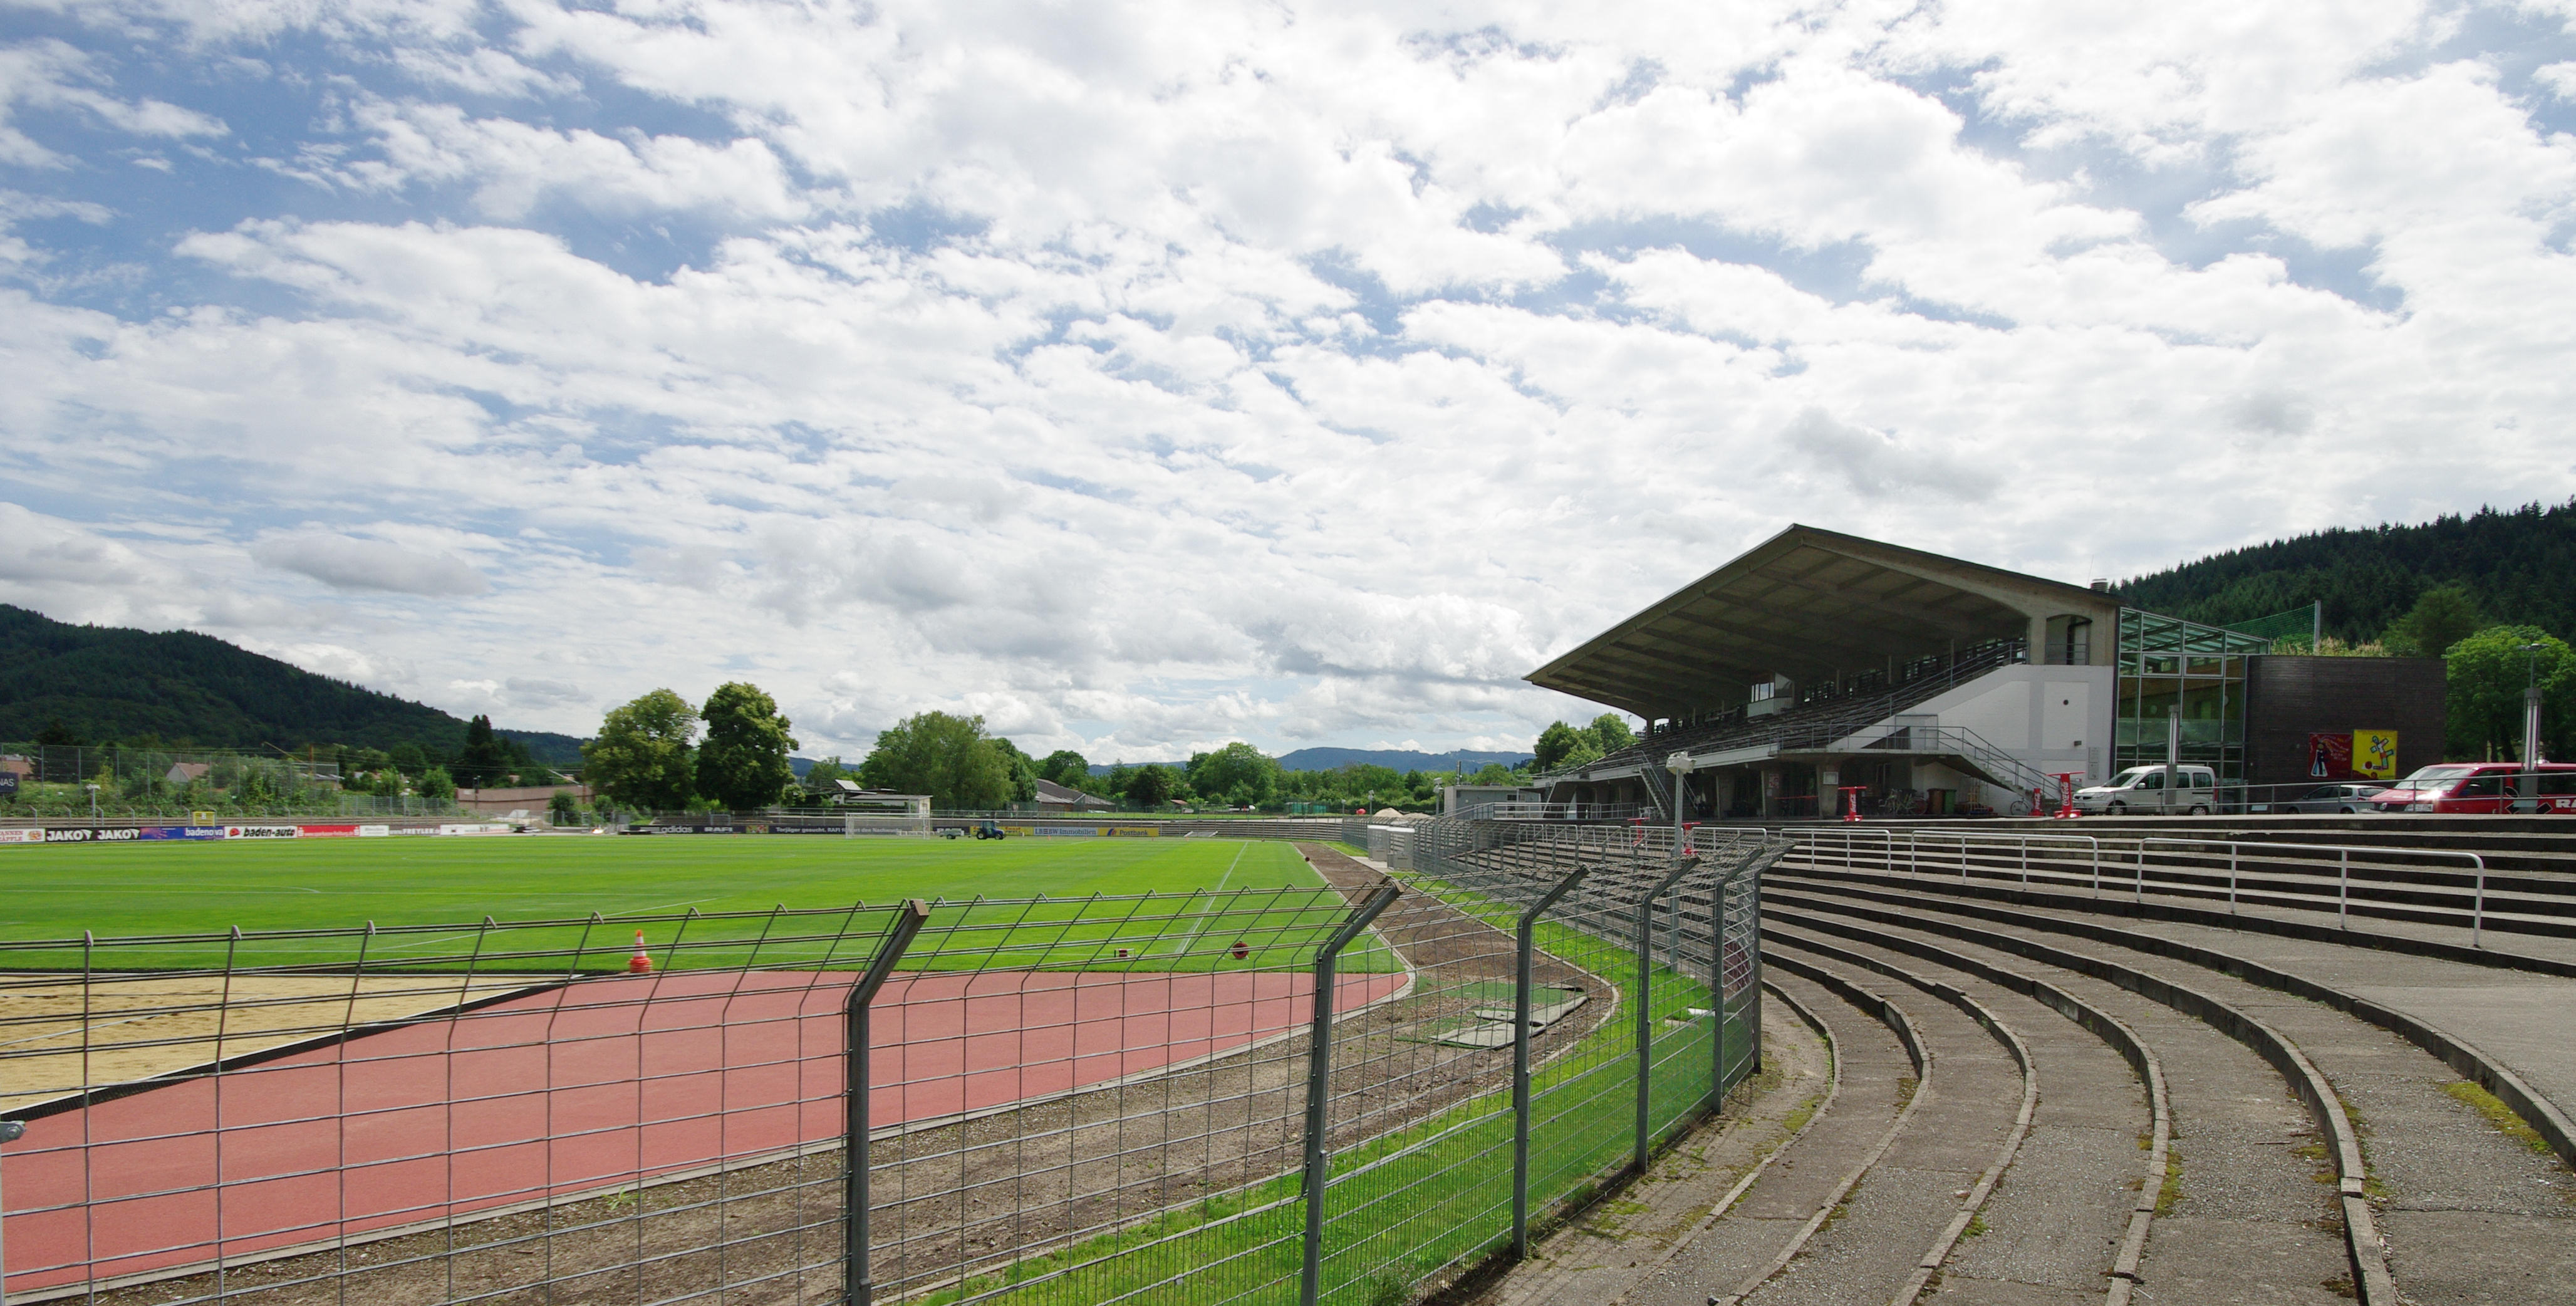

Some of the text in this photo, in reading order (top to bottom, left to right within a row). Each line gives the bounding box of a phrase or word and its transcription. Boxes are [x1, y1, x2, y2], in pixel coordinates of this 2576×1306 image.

[47, 830, 83, 841] JAKO
[97, 829, 132, 840] JAKO
[185, 827, 224, 836] badenova
[243, 827, 296, 837] baden-auto
